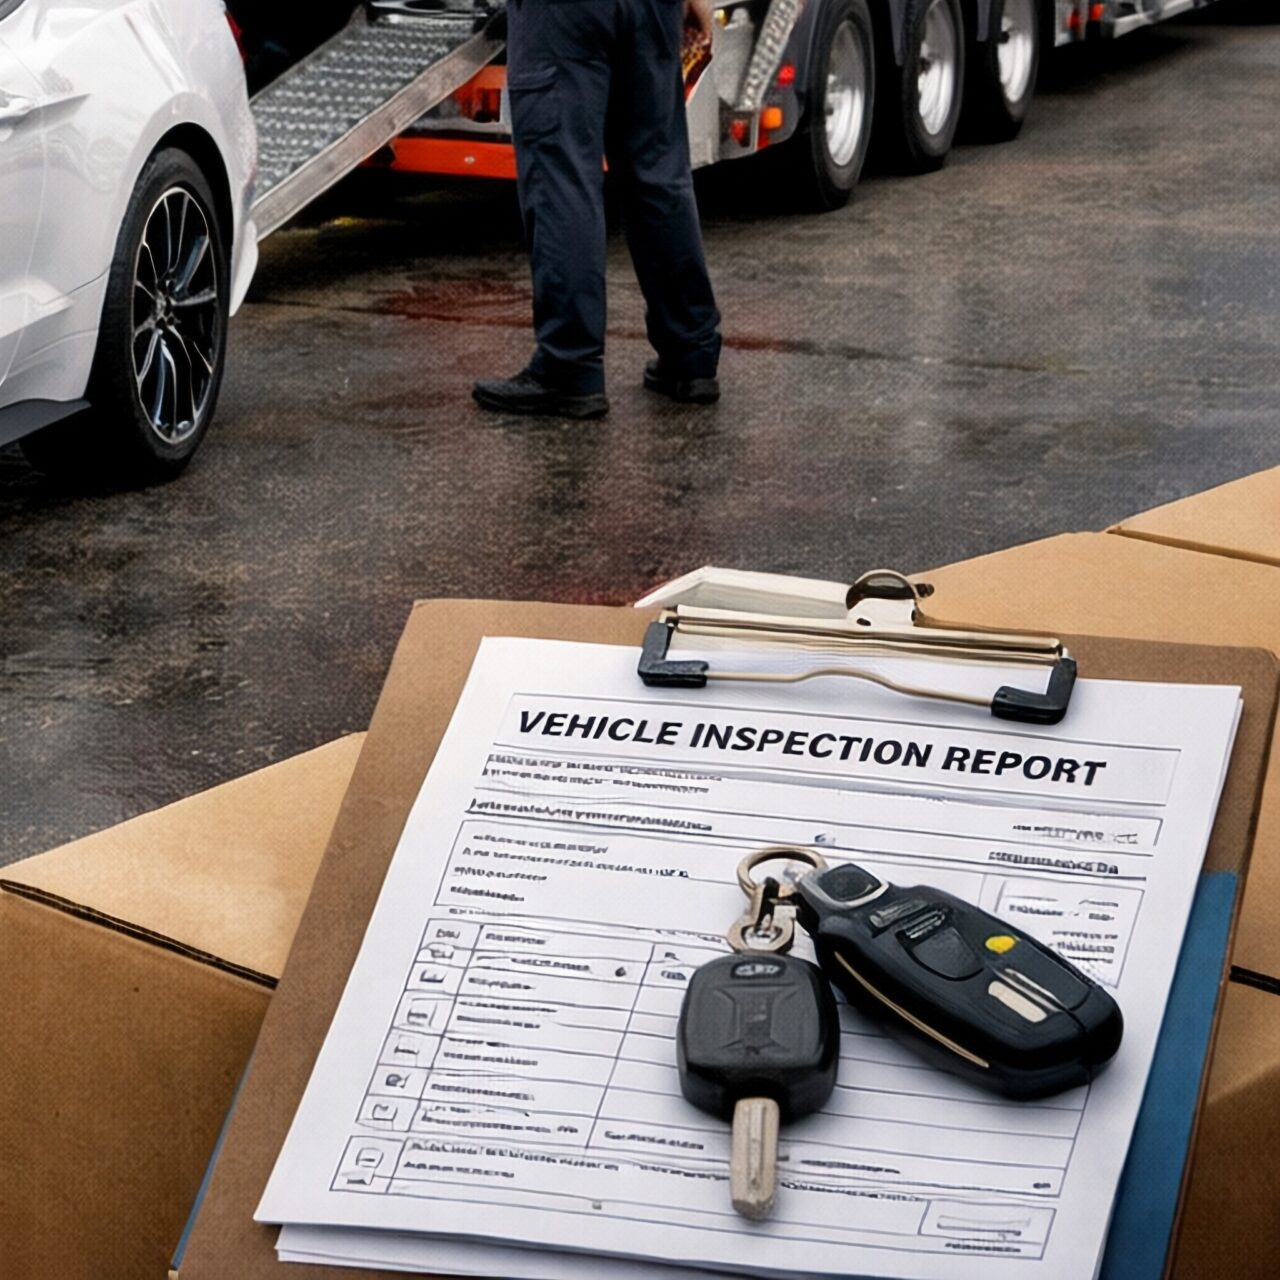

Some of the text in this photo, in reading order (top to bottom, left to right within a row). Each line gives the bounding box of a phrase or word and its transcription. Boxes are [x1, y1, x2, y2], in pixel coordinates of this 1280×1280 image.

[519, 711, 682, 746] VEHICLE
[689, 723, 937, 768] INSPECTION
[941, 748, 1108, 787] REPORT
